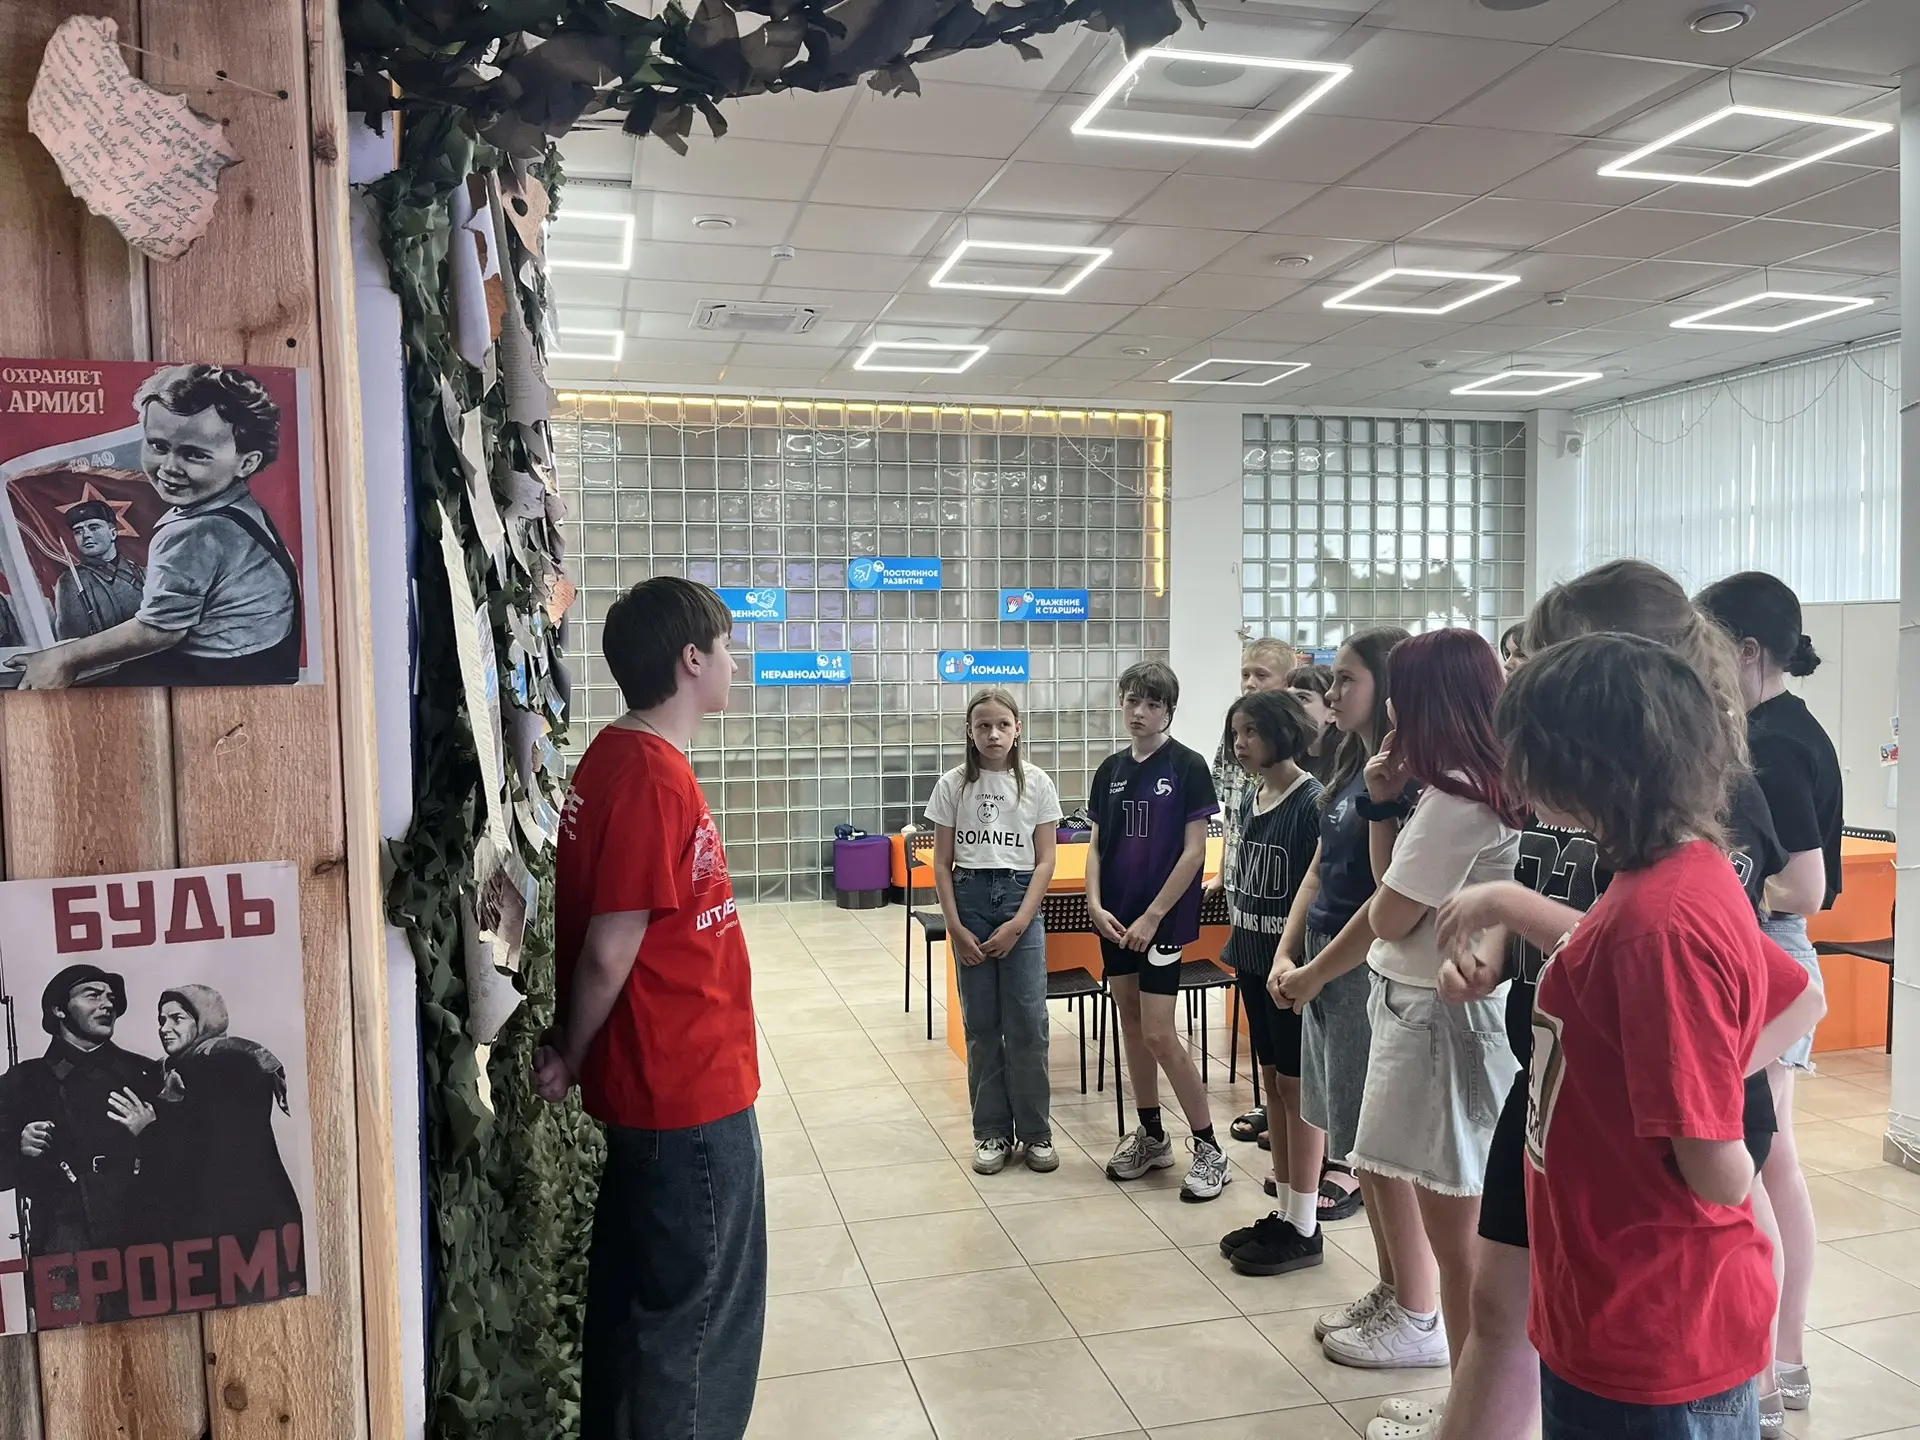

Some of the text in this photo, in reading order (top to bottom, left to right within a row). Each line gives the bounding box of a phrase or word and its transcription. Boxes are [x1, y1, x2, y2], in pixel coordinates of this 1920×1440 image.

[2, 367, 103, 386] ОХРАНЯЕТ
[7, 388, 105, 415] АРМИЯ!
[883, 569, 939, 577] ПОСТОЯННОЕ
[883, 577, 924, 585] РАЗВИТИЕ
[1035, 598, 1081, 607] УВАЖЕНИЕ
[1035, 606, 1085, 615] К СТАРШИМ
[761, 669, 846, 680] НЕРАВНОДУШИЕ
[971, 665, 1025, 676] КОМАНДА
[1122, 800, 1149, 838] 11
[956, 830, 1025, 848] SOIANEL
[52, 872, 276, 954] БУДЬ
